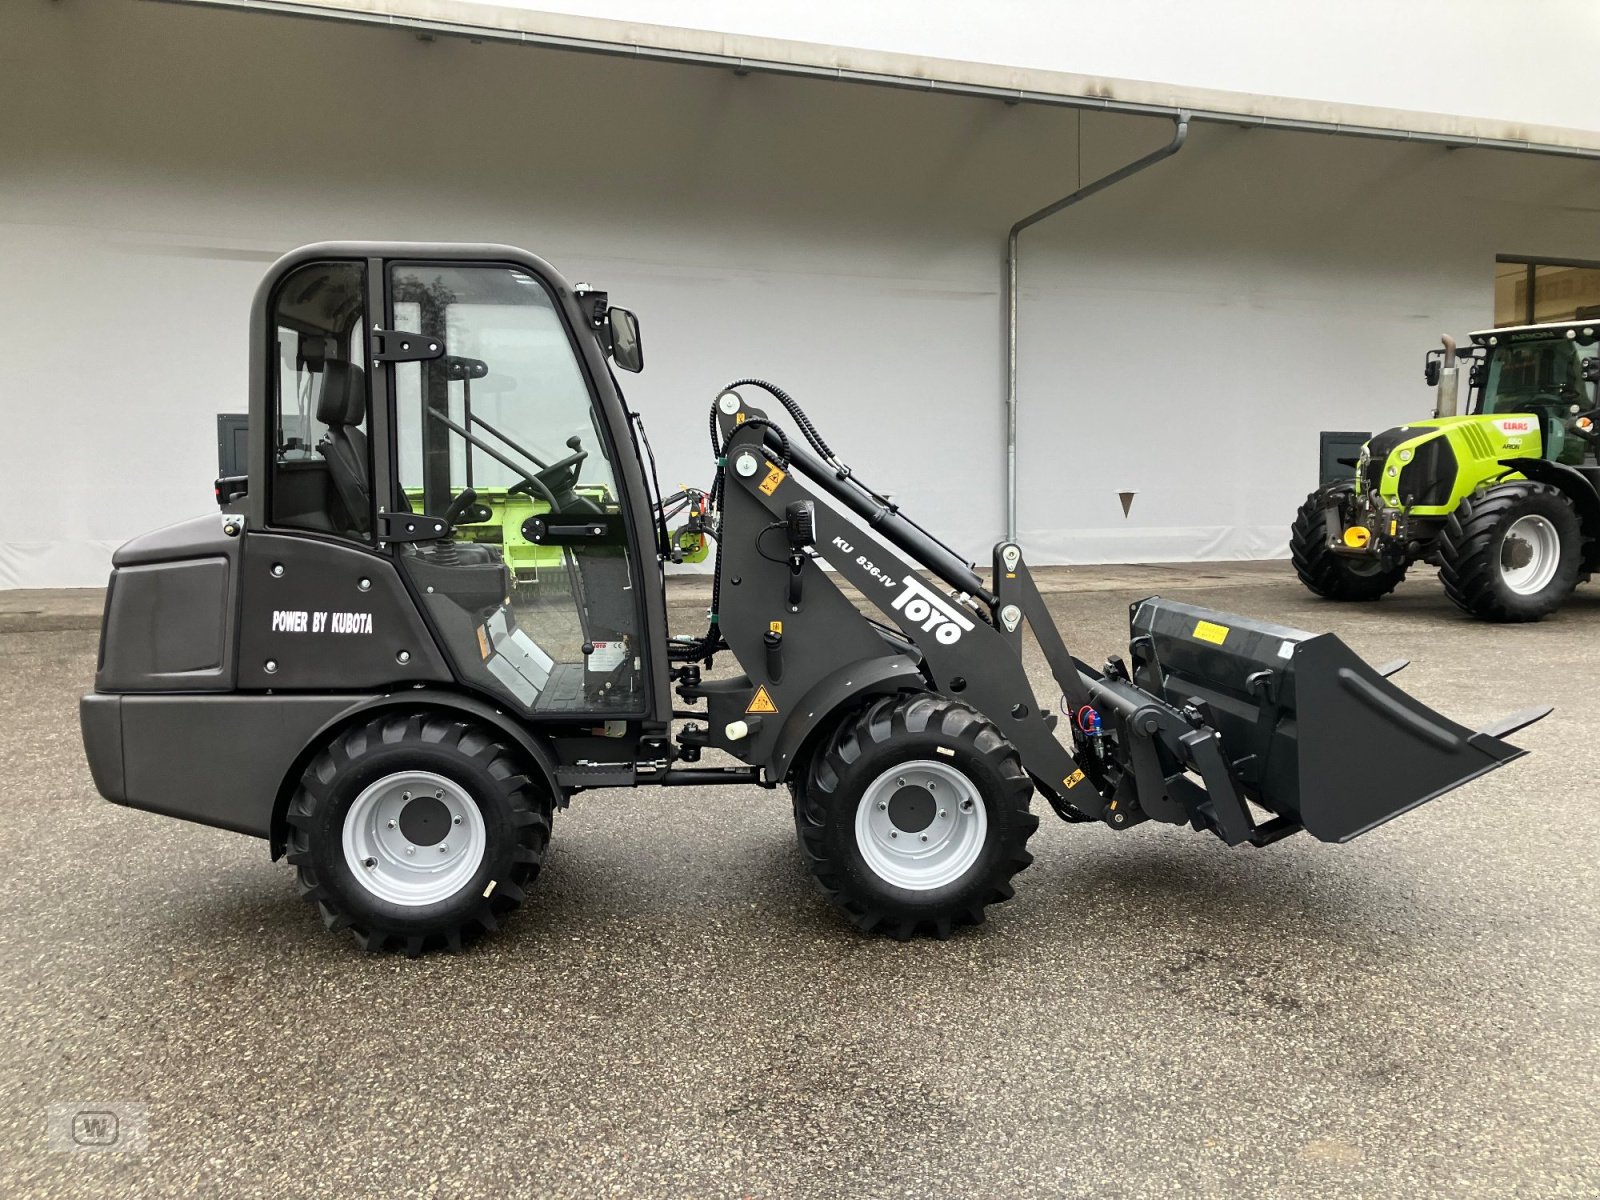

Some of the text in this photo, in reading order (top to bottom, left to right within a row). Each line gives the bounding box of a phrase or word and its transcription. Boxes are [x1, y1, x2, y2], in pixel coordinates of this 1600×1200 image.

[1503, 421, 1529, 431] CLAAS
[832, 536, 897, 588] KU 836-IV
[272, 610, 373, 634] POWER BY KUBOTA
[890, 575, 976, 645] TOYO
